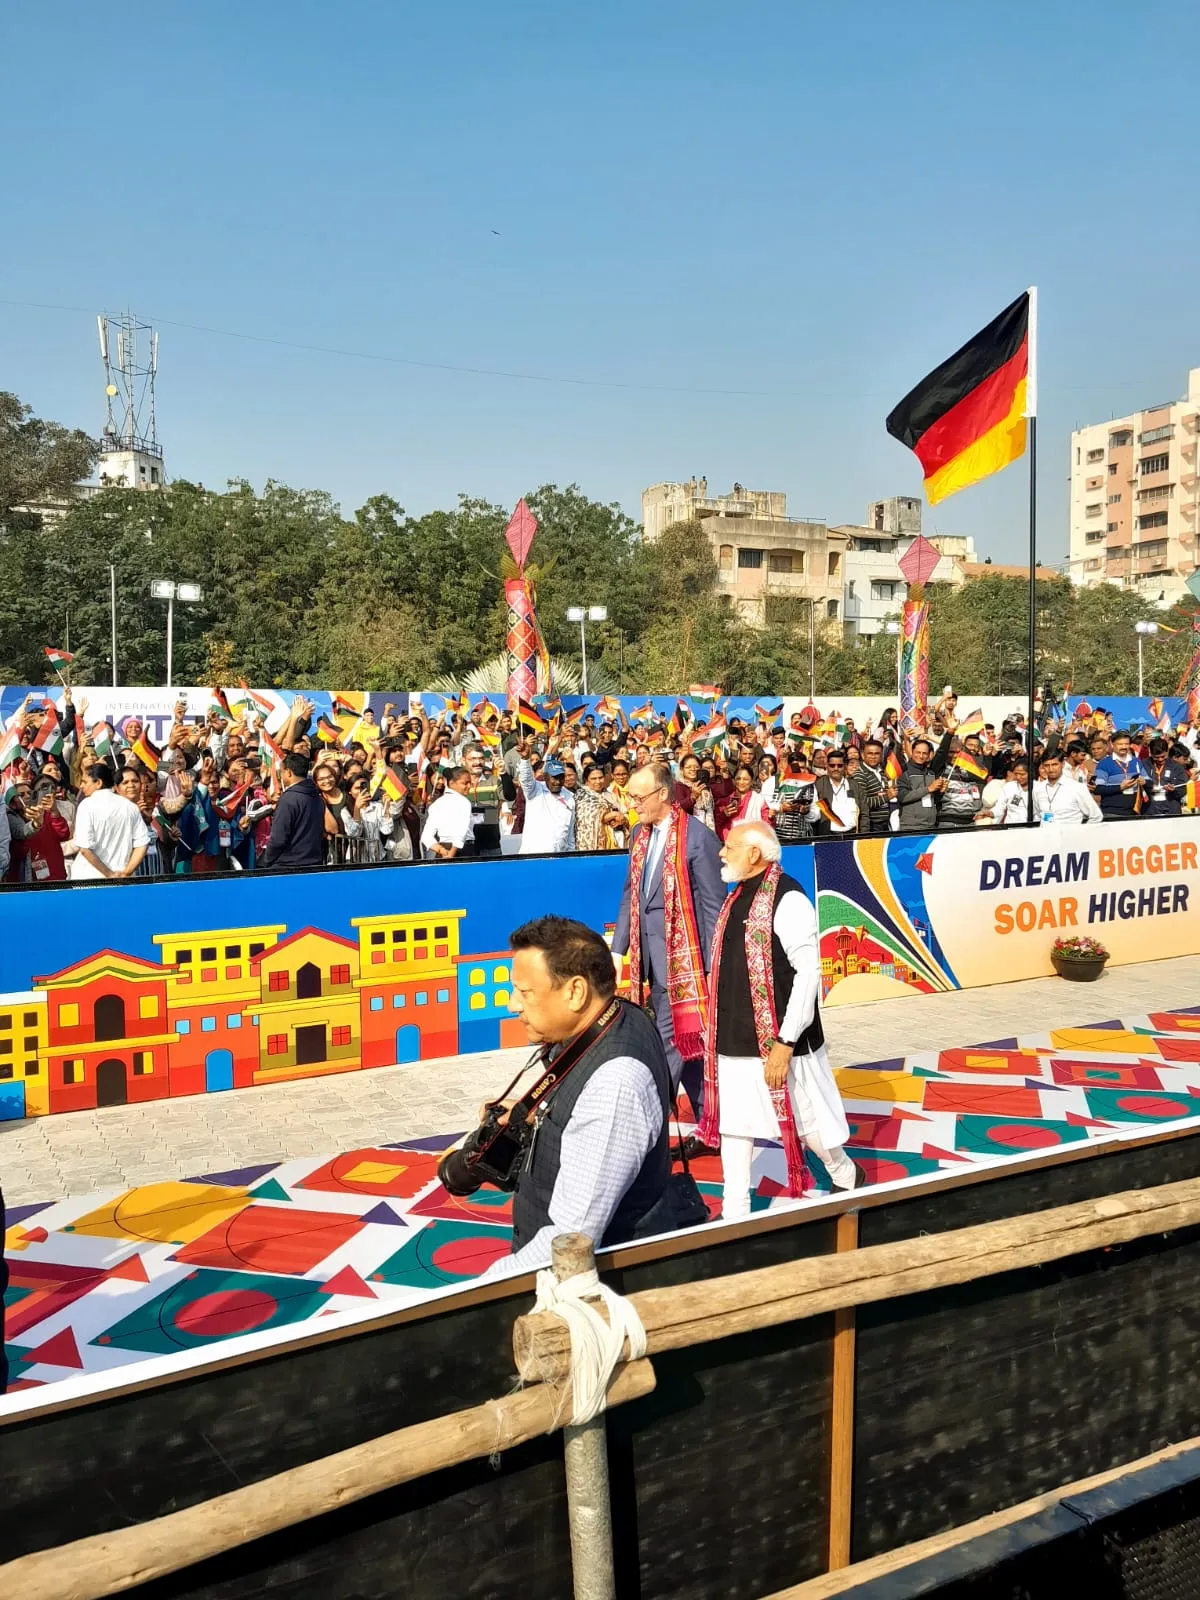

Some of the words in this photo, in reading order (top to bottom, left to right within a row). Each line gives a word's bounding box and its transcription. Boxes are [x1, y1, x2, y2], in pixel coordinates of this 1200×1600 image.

[105, 702, 196, 711] INTERNATIOL
[979, 851, 1090, 891] DREAM
[1098, 841, 1198, 879] BIGGER
[994, 896, 1078, 935] SOAR
[1088, 884, 1189, 923] HIGHER
[598, 999, 620, 1026] Canon
[531, 1073, 556, 1099] Canon
